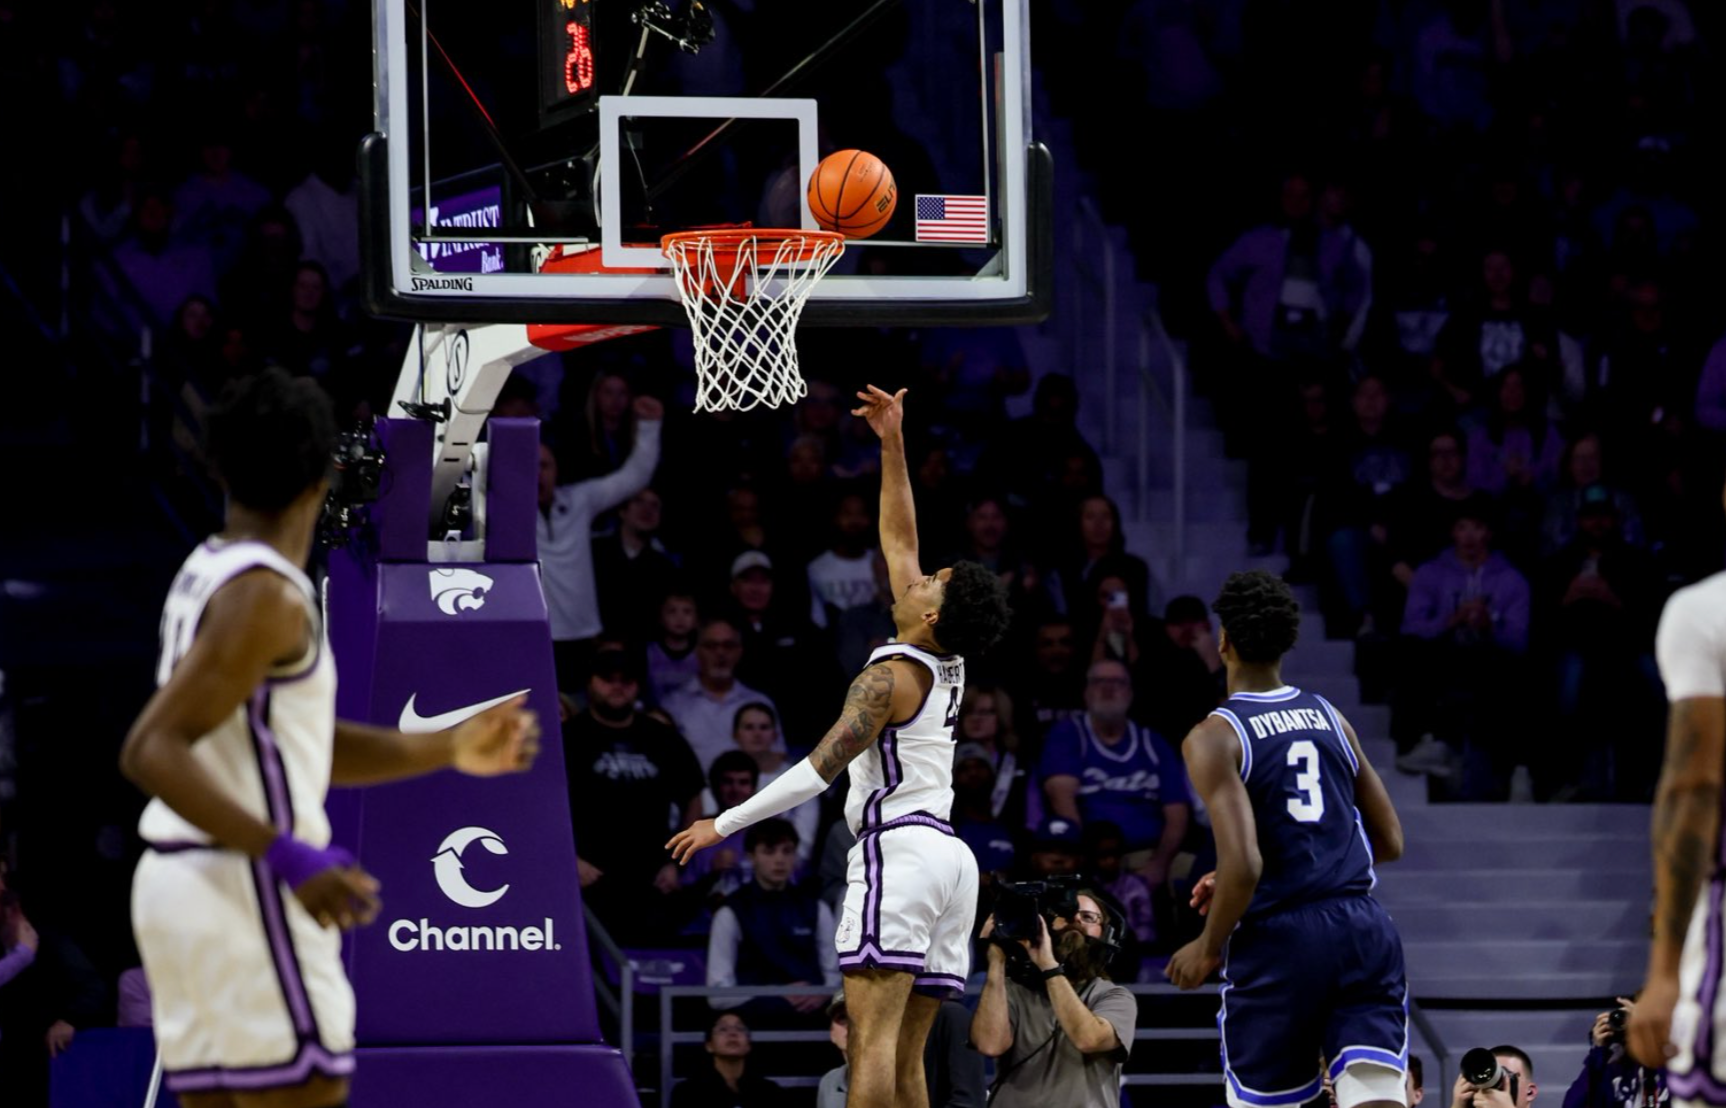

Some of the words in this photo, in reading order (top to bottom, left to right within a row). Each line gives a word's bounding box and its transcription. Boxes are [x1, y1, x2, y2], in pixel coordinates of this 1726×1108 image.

[411, 277, 473, 291] SPALDING
[1248, 708, 1332, 740] DYBANTSA
[1287, 740, 1325, 822] 3
